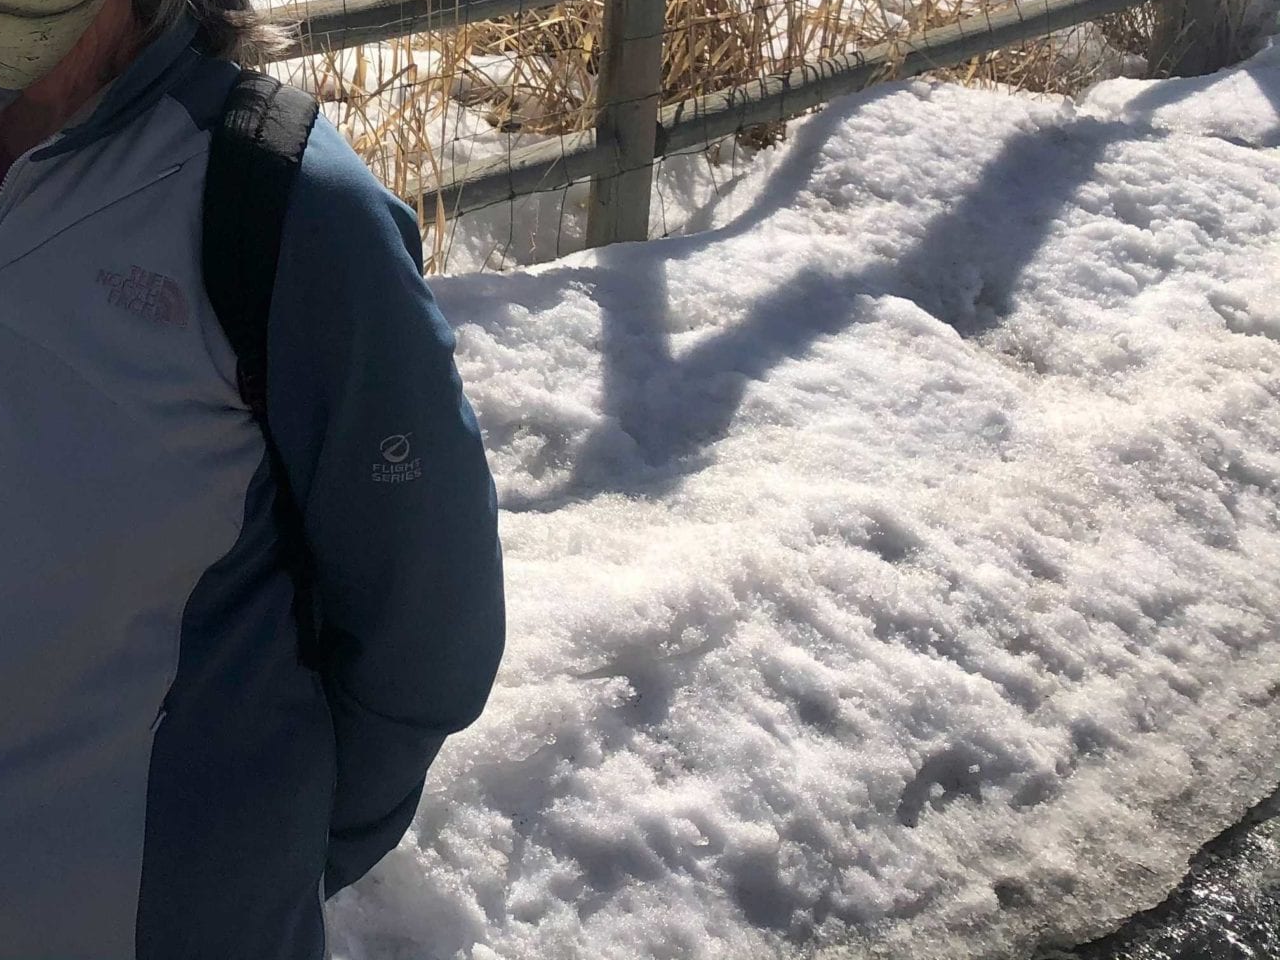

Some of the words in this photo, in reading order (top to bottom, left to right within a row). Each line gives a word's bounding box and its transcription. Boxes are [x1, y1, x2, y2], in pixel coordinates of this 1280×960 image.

[96, 268, 162, 303] NORTH
[130, 265, 163, 288] THE
[107, 287, 162, 321] FACE
[371, 469, 422, 483] SERIES
[372, 458, 422, 473] FLIGHT
